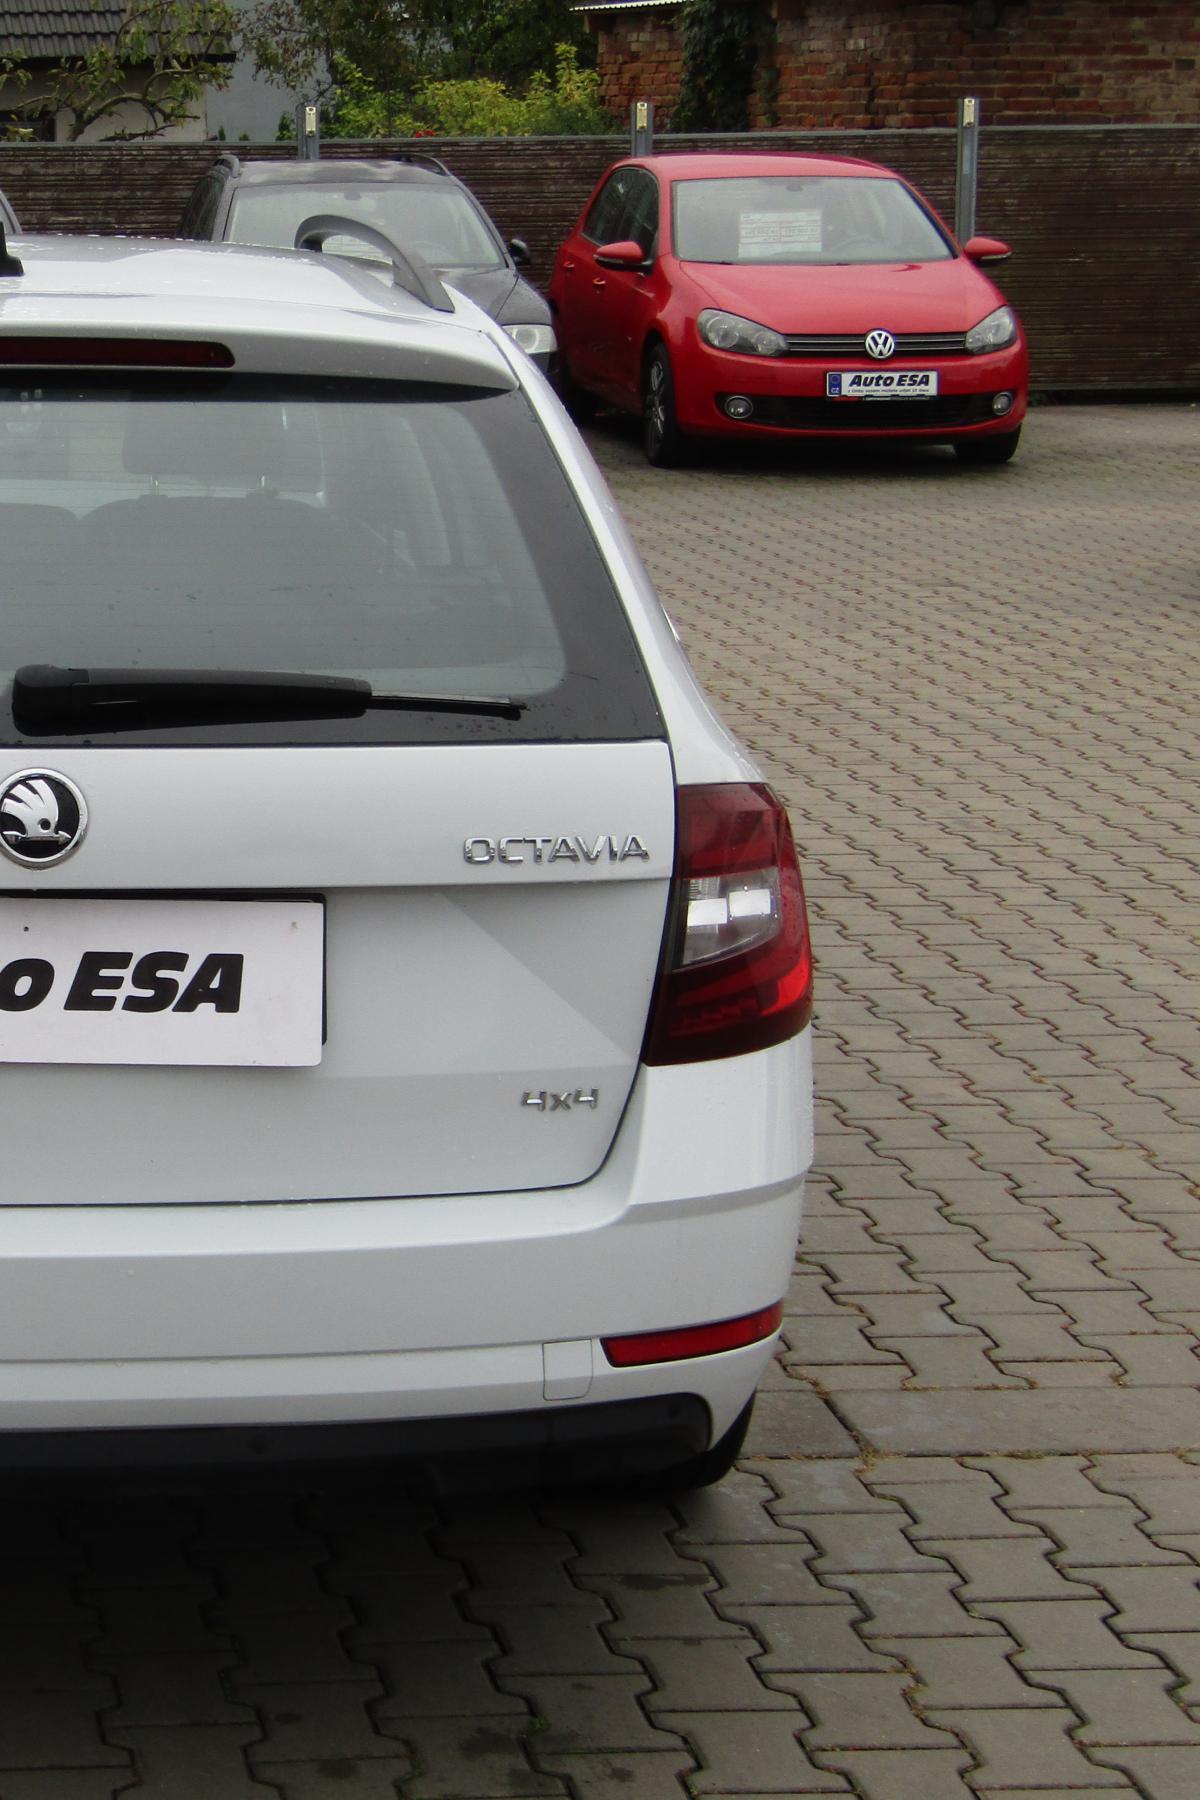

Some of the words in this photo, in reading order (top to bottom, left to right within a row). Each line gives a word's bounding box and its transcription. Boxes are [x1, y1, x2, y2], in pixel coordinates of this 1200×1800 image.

[848, 374, 894, 387] Auto
[896, 374, 930, 387] ESA
[463, 834, 650, 865] OCTAVIA
[63, 951, 245, 1013] ESA
